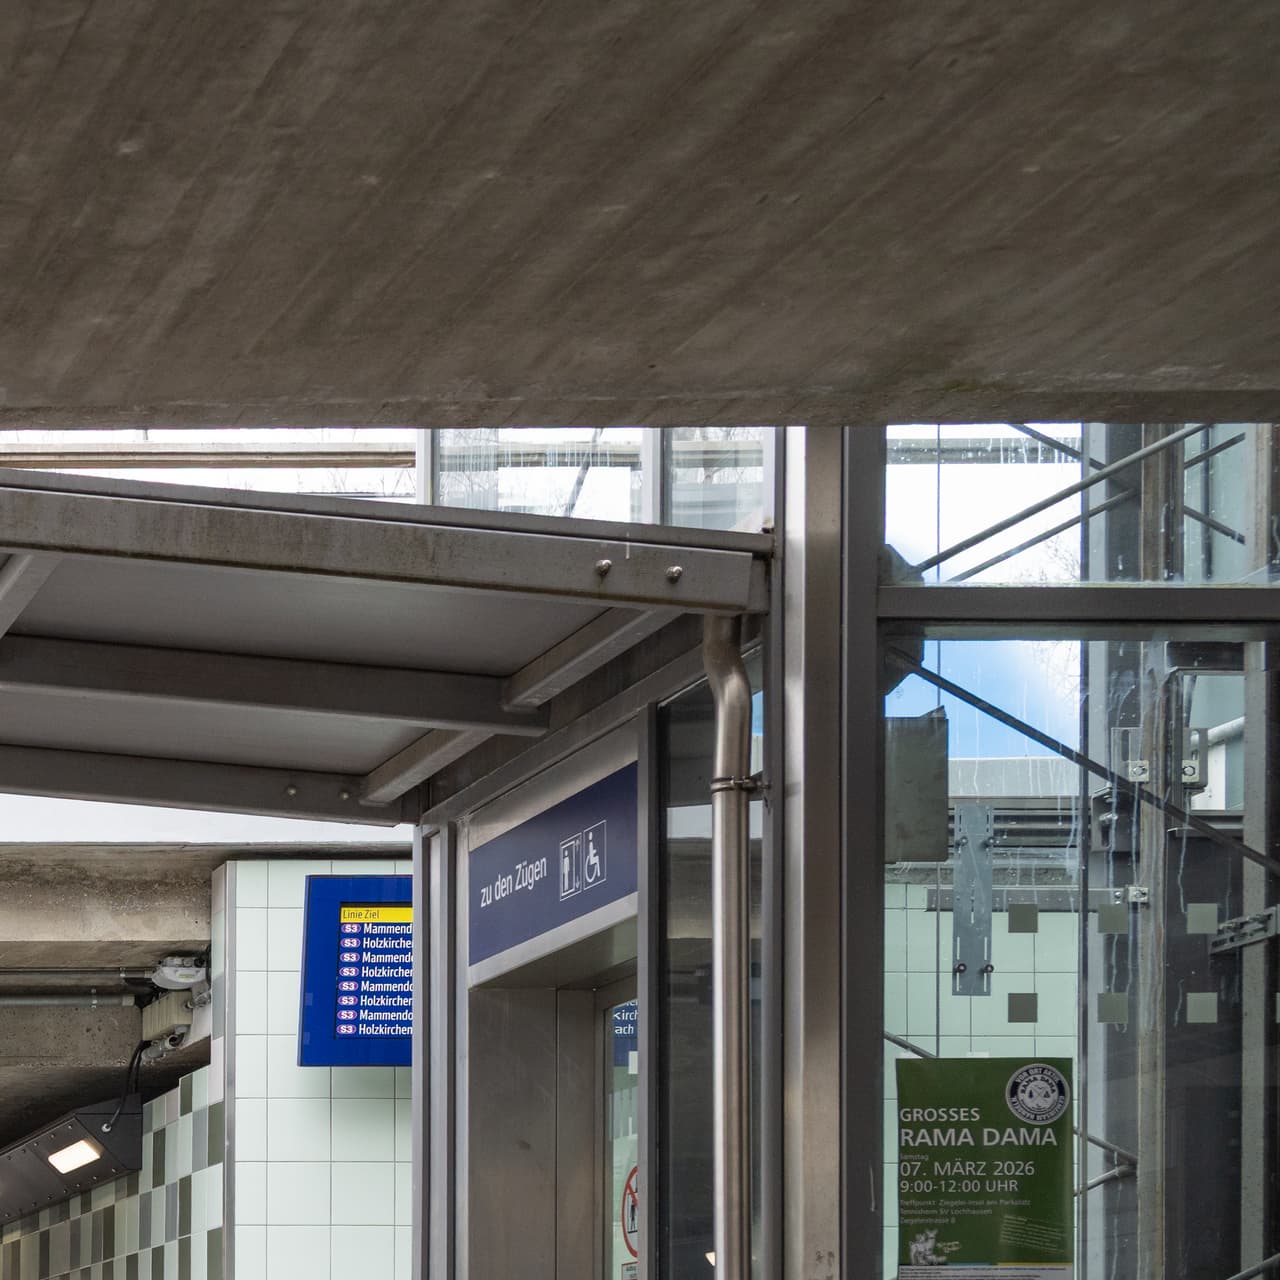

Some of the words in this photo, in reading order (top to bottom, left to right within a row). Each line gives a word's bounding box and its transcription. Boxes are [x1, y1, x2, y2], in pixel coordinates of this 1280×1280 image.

[480, 884, 492, 908] zu
[494, 874, 512, 901] den
[514, 857, 547, 891] Zügen
[343, 909, 363, 919] Linie
[364, 909, 380, 919] Ziel
[345, 924, 358, 933] S3
[344, 938, 357, 947] S3
[363, 937, 413, 949] Holzkirche
[344, 953, 357, 962] S3
[343, 967, 356, 976] S3
[342, 982, 355, 990] S3
[341, 996, 354, 1005] S3
[341, 1011, 354, 1019] S3
[359, 1010, 413, 1020] Mammendo
[340, 1025, 353, 1034] S3
[358, 1024, 413, 1035] Holzkirchen
[900, 1108, 981, 1122] GROSSES
[900, 1128, 975, 1146] RAMA
[983, 1128, 1058, 1146] DAMA
[900, 1161, 927, 1176] 07.
[934, 1158, 987, 1176] MÄRZ
[993, 1161, 1035, 1176] 2026
[900, 1180, 981, 1193] 9:00-12:00
[986, 1179, 1019, 1192] UHR
